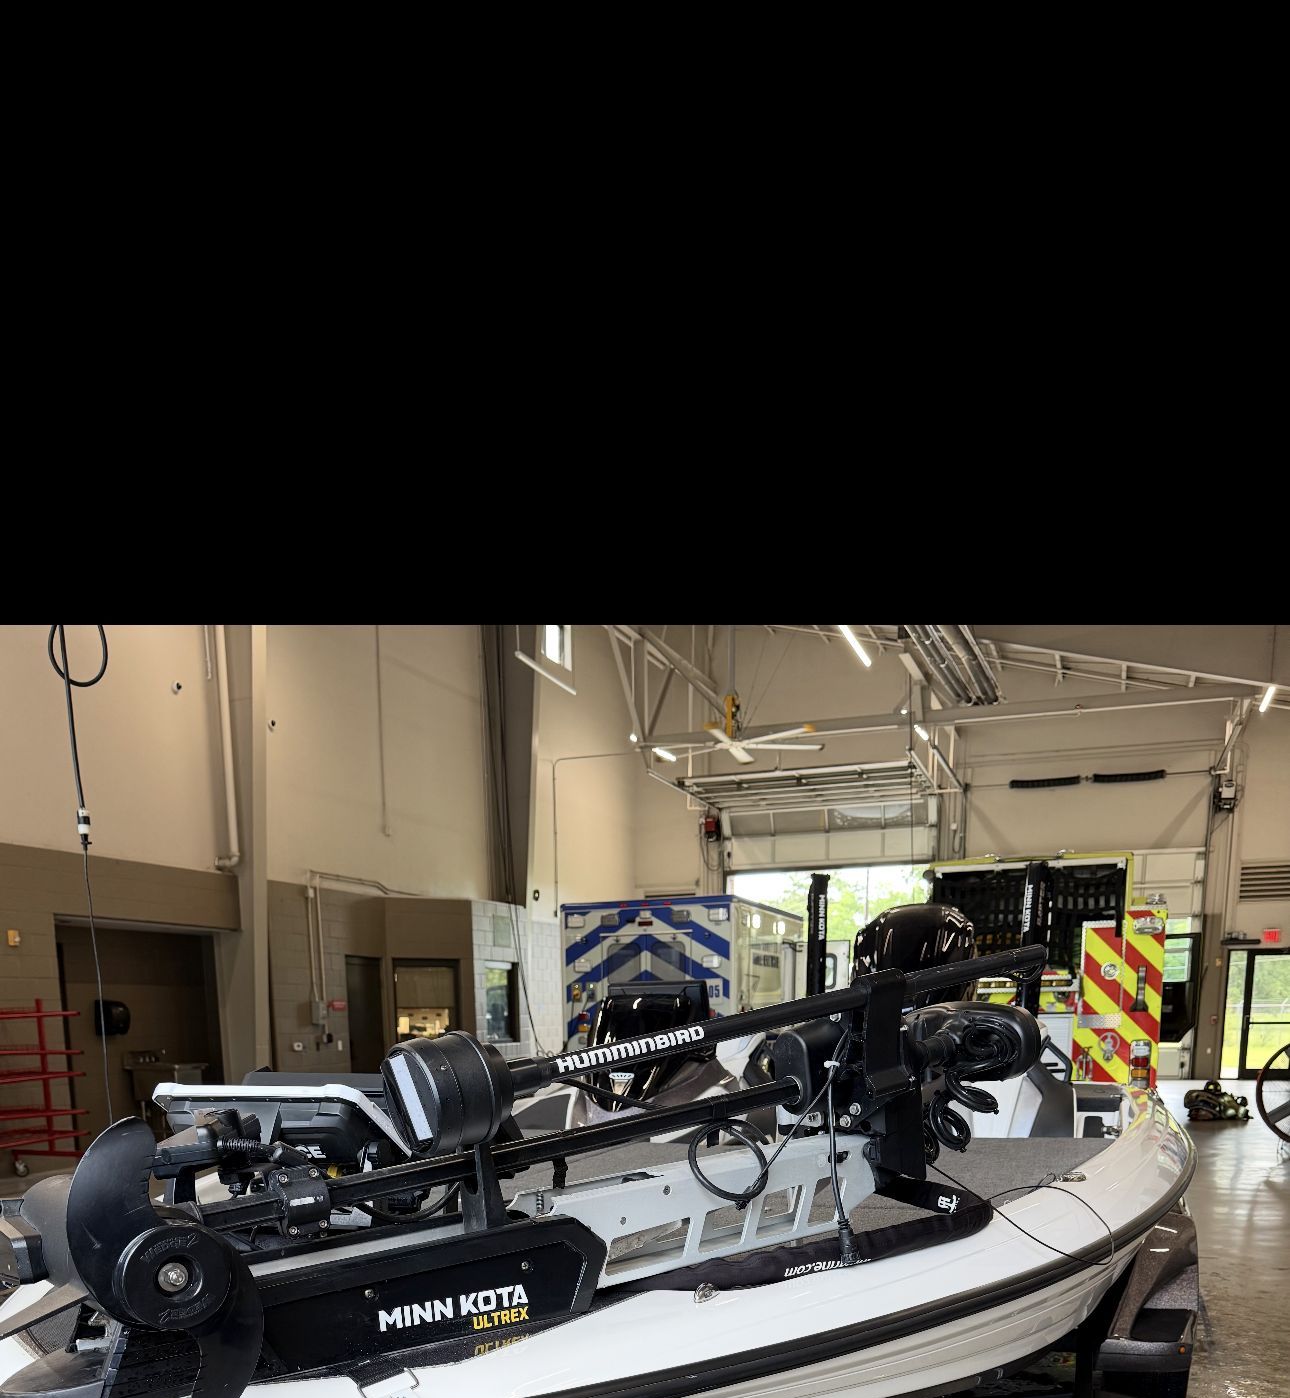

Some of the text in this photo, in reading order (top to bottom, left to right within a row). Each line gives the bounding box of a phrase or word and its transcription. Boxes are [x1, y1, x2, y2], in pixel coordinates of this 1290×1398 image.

[818, 894, 826, 941] MINN KOTA
[1023, 884, 1034, 933] MINN KOTA
[556, 1025, 705, 1074] HUMMINBIRD
[378, 1283, 529, 1332] MINN KOTA
[473, 1305, 529, 1330] ULTREX
